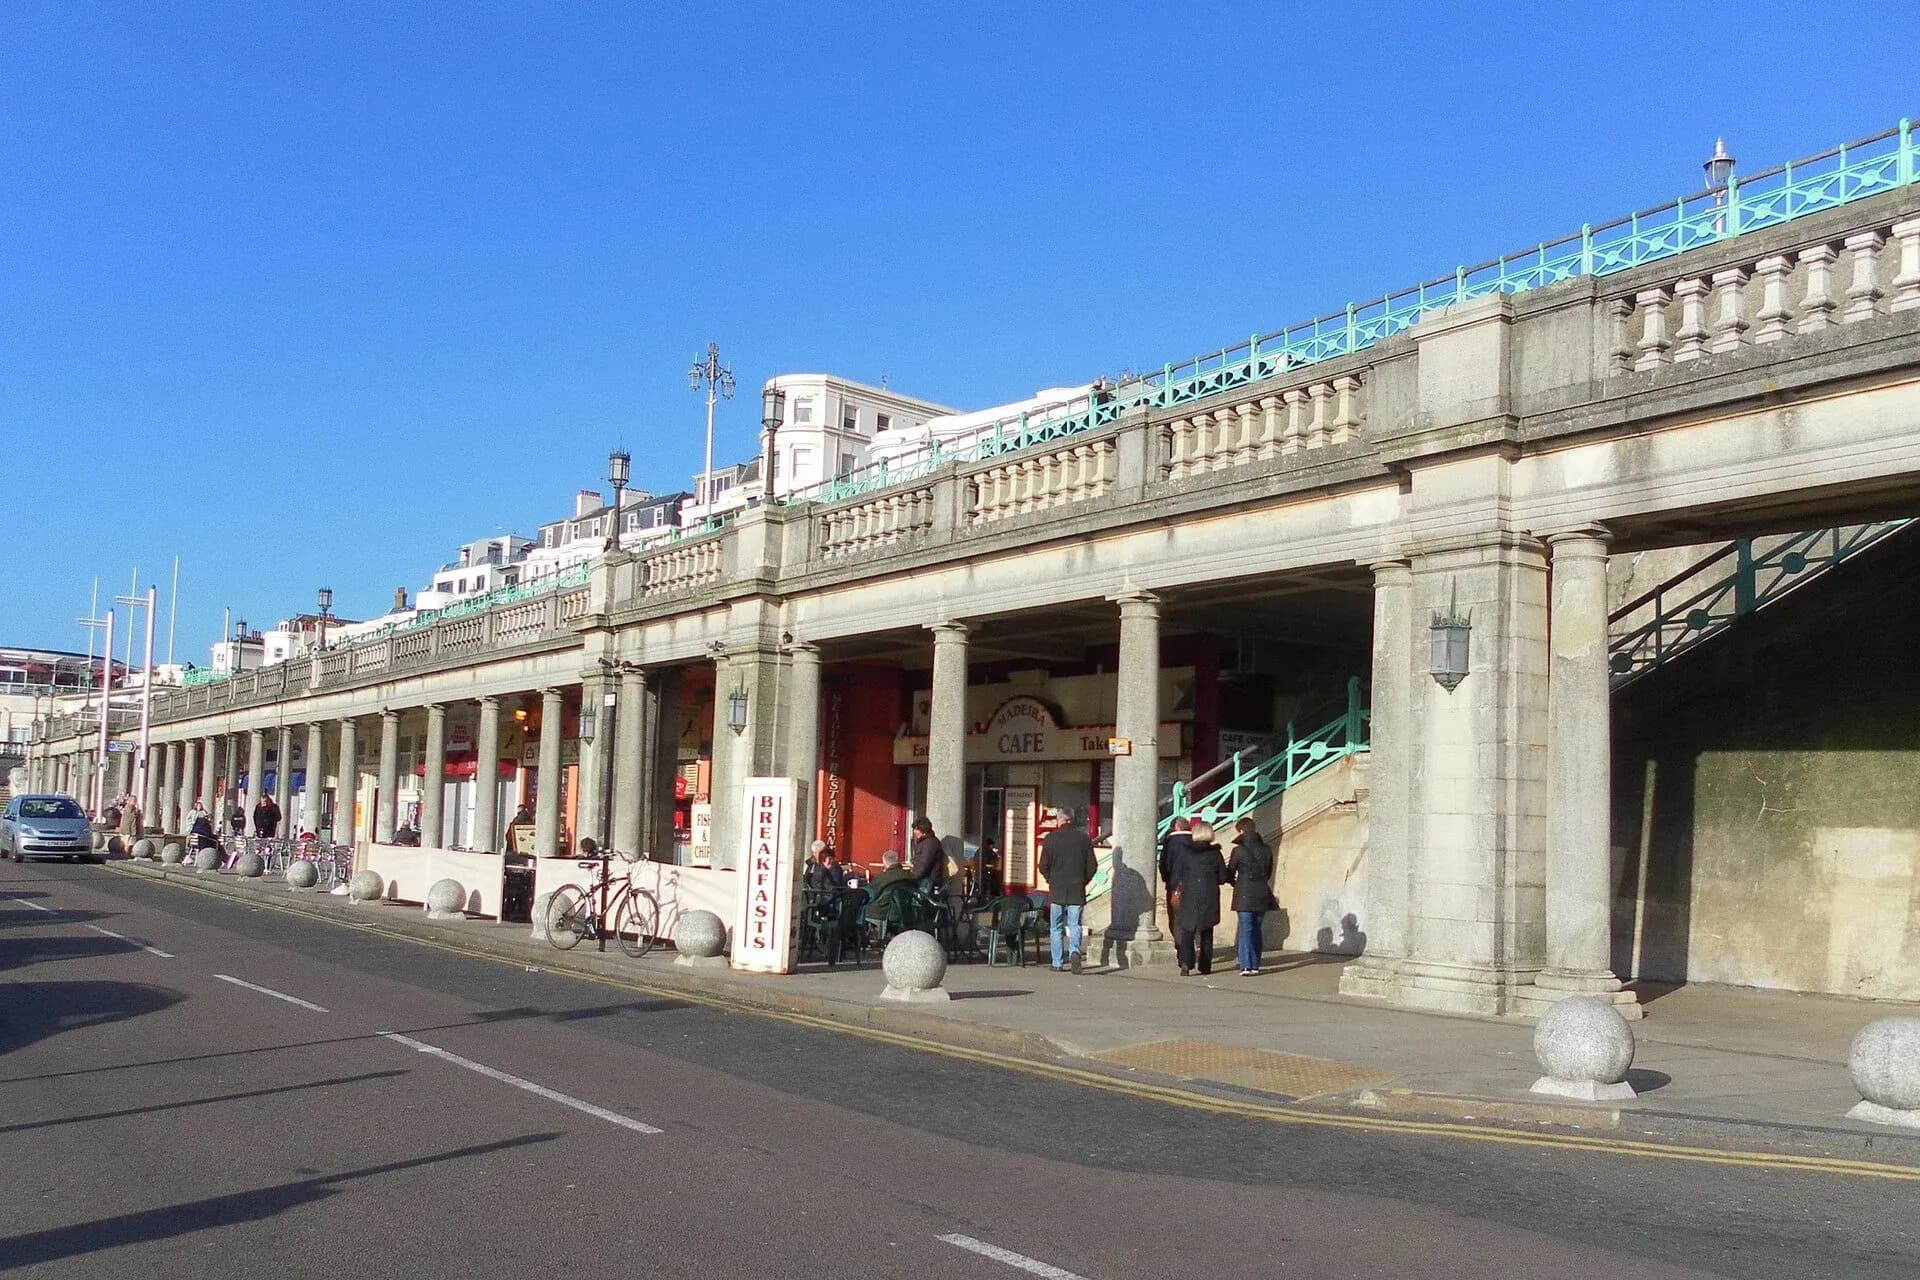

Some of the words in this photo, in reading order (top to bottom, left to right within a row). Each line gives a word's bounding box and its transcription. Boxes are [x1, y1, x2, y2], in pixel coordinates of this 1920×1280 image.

[997, 703, 1046, 729] MADEIRA
[912, 743, 930, 757] Eat
[998, 733, 1045, 753] CAFE
[694, 845, 711, 859] CHIP
[752, 795, 774, 949] BREAKFASTS
